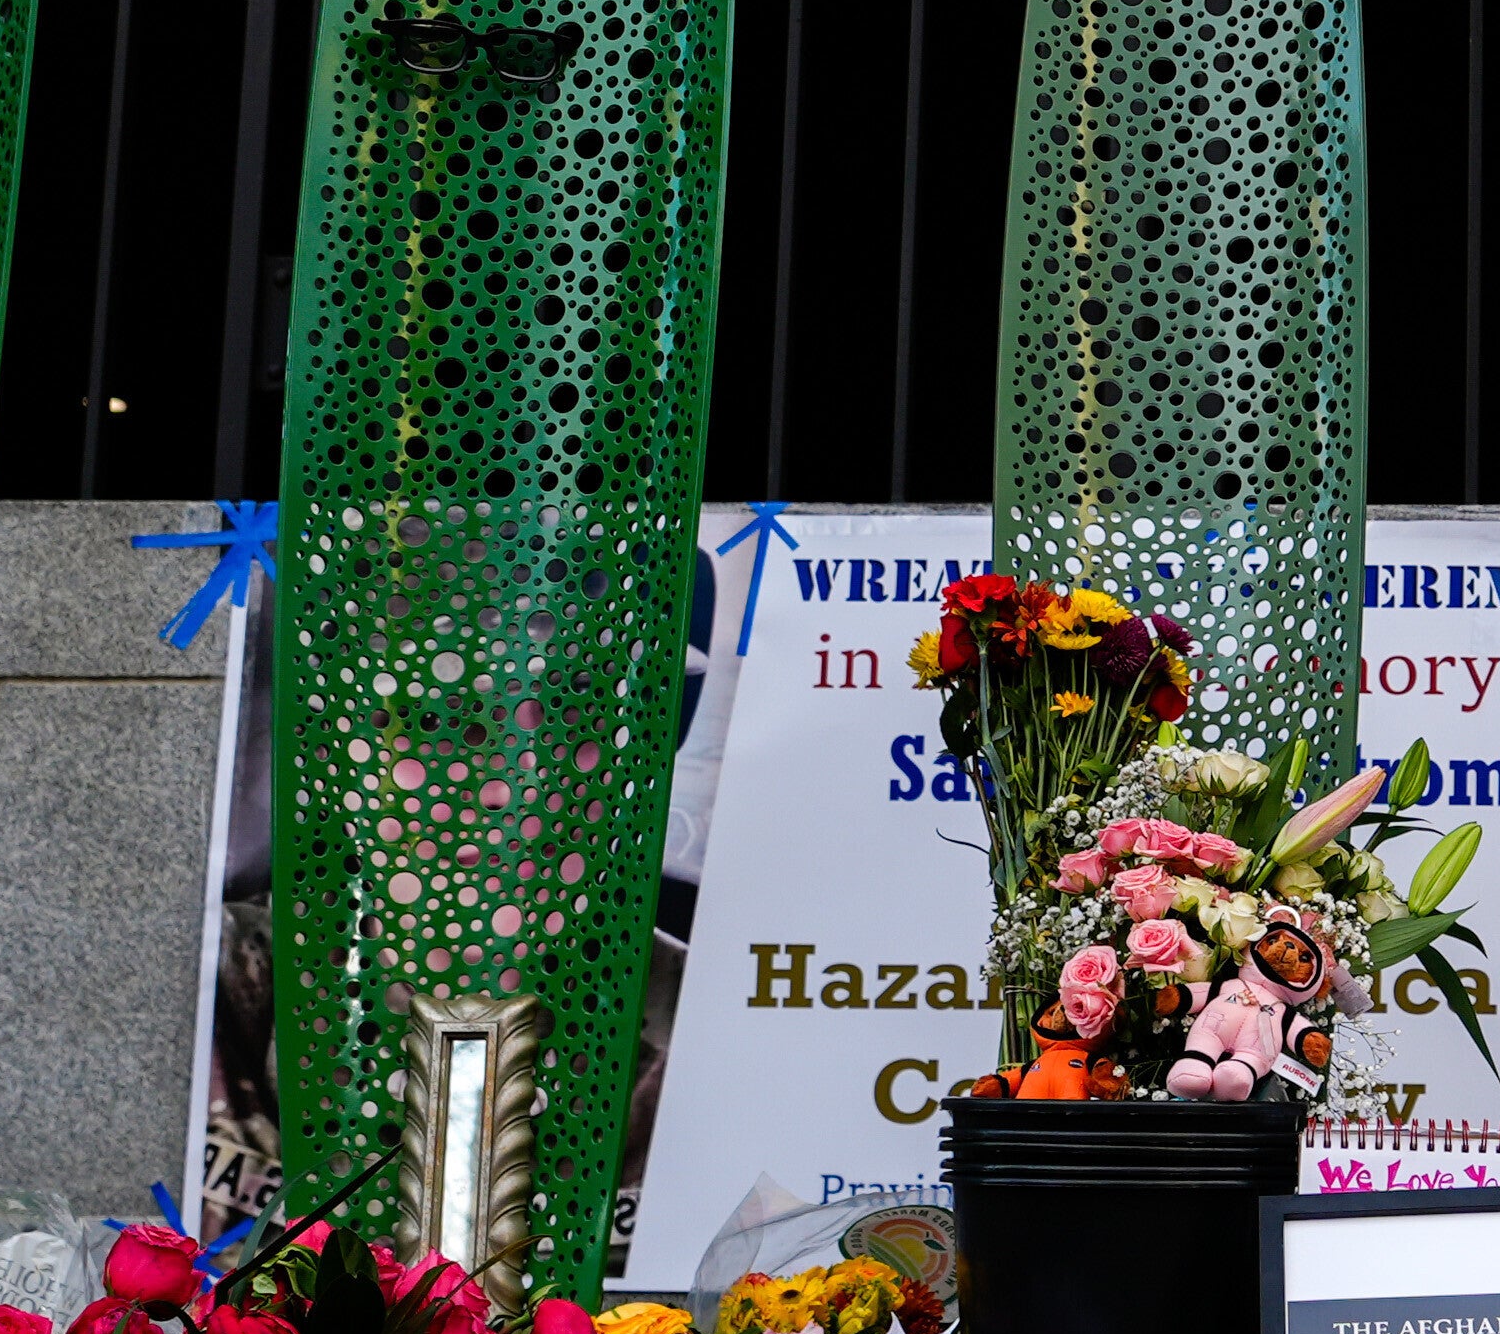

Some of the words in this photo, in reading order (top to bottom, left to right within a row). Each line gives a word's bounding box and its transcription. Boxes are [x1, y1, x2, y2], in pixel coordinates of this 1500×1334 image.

[792, 558, 994, 602] WREA
[813, 632, 883, 689] in
[746, 943, 1004, 1010] Hazar
[820, 1173, 954, 1209] Prayin
[1316, 1157, 1374, 1191] We
[1386, 1158, 1455, 1192] Love
